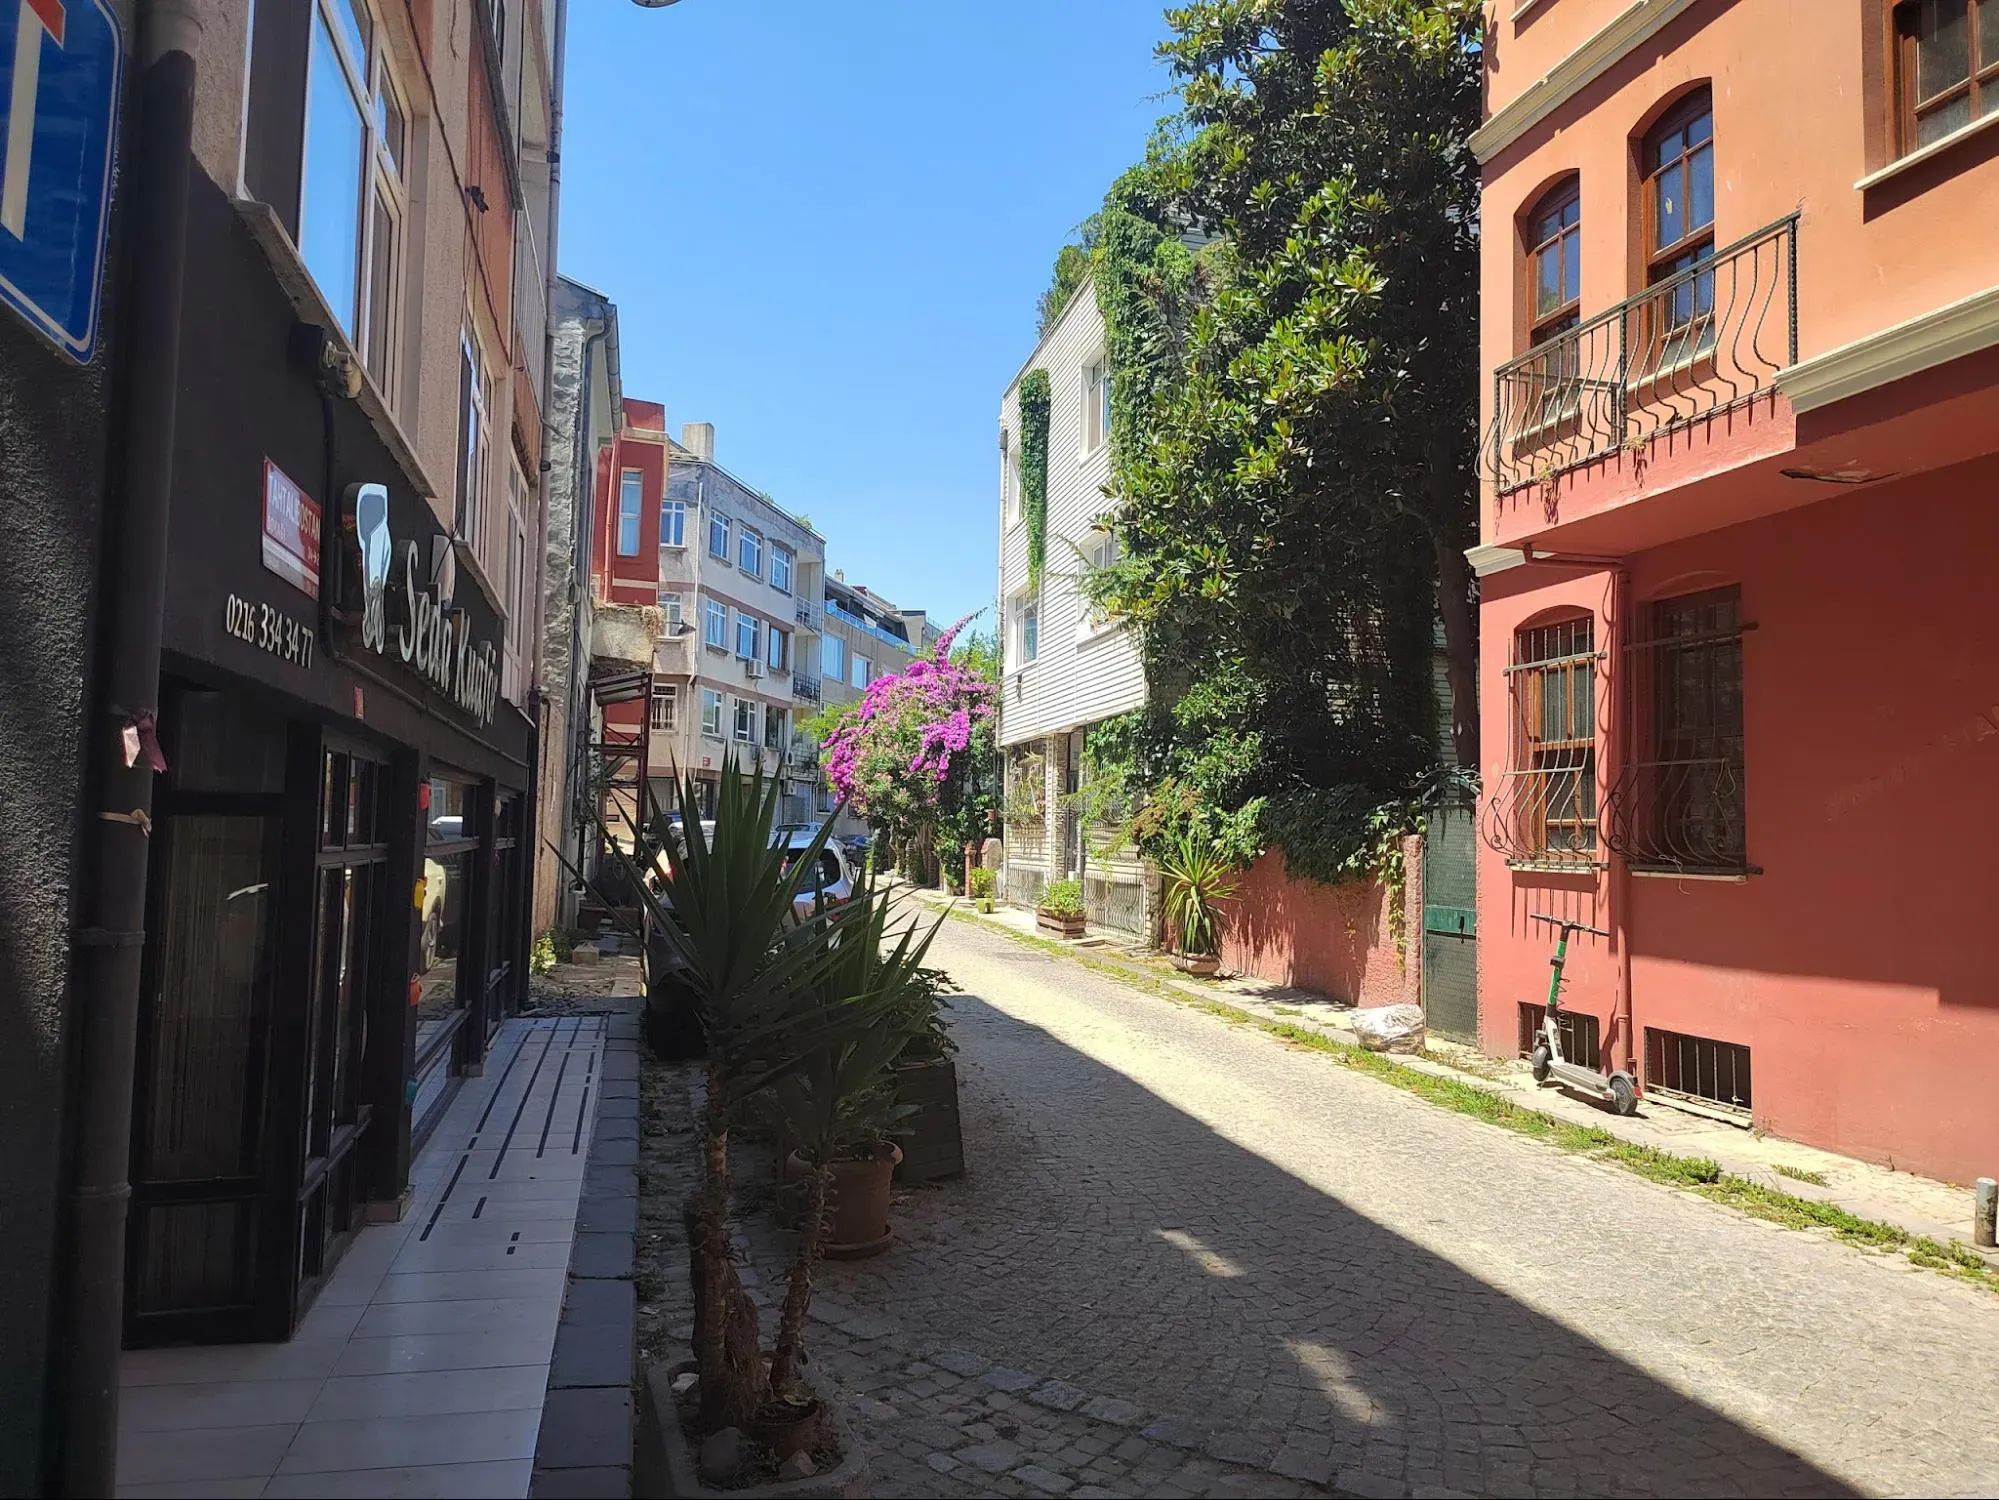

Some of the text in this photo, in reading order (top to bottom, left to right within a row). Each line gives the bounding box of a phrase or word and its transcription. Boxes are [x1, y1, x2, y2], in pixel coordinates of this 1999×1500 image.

[226, 593, 314, 670] 0216 334 34 77
[399, 539, 452, 693] Seda
